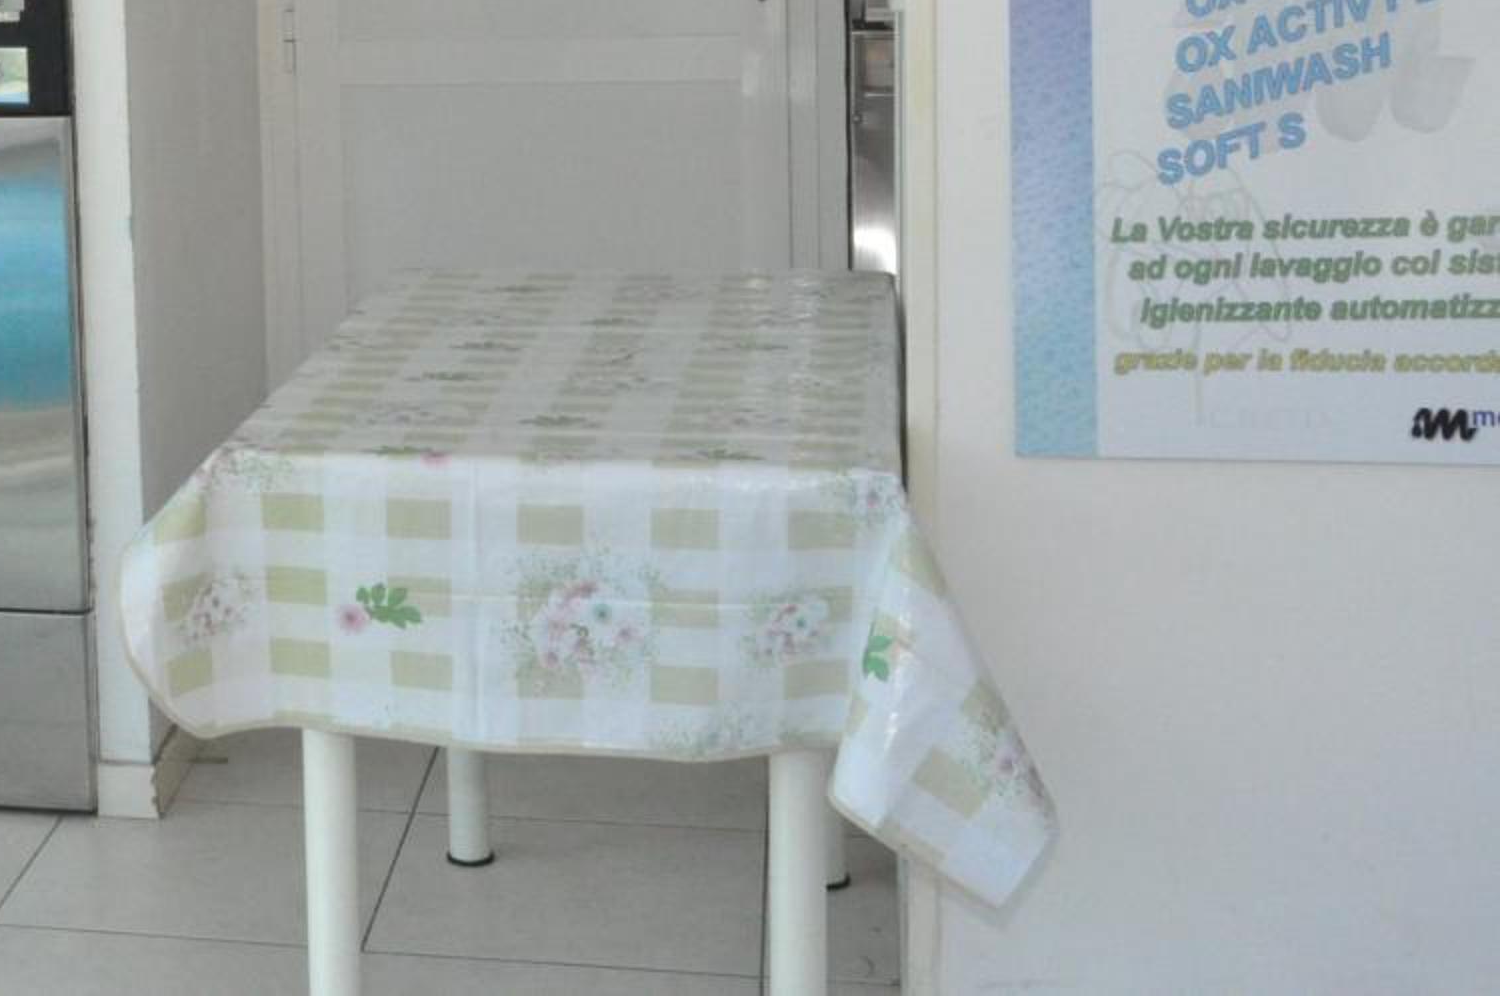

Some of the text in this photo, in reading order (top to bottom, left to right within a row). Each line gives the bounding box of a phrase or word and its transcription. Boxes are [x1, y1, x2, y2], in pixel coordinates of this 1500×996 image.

[1175, 25, 1237, 74] OX
[1166, 31, 1392, 130] SANIWASH
[1157, 111, 1307, 186] SOFT S
[1111, 216, 1148, 243] La
[1157, 215, 1254, 242] Vostra
[1262, 212, 1411, 240] sicurezza
[1128, 253, 1167, 281] ad
[1174, 252, 1243, 286] ogni
[1250, 249, 1382, 284] lavaggio
[1140, 296, 1322, 330] igienizzante
[1114, 348, 1198, 376] grazie
[1203, 352, 1252, 377] per
